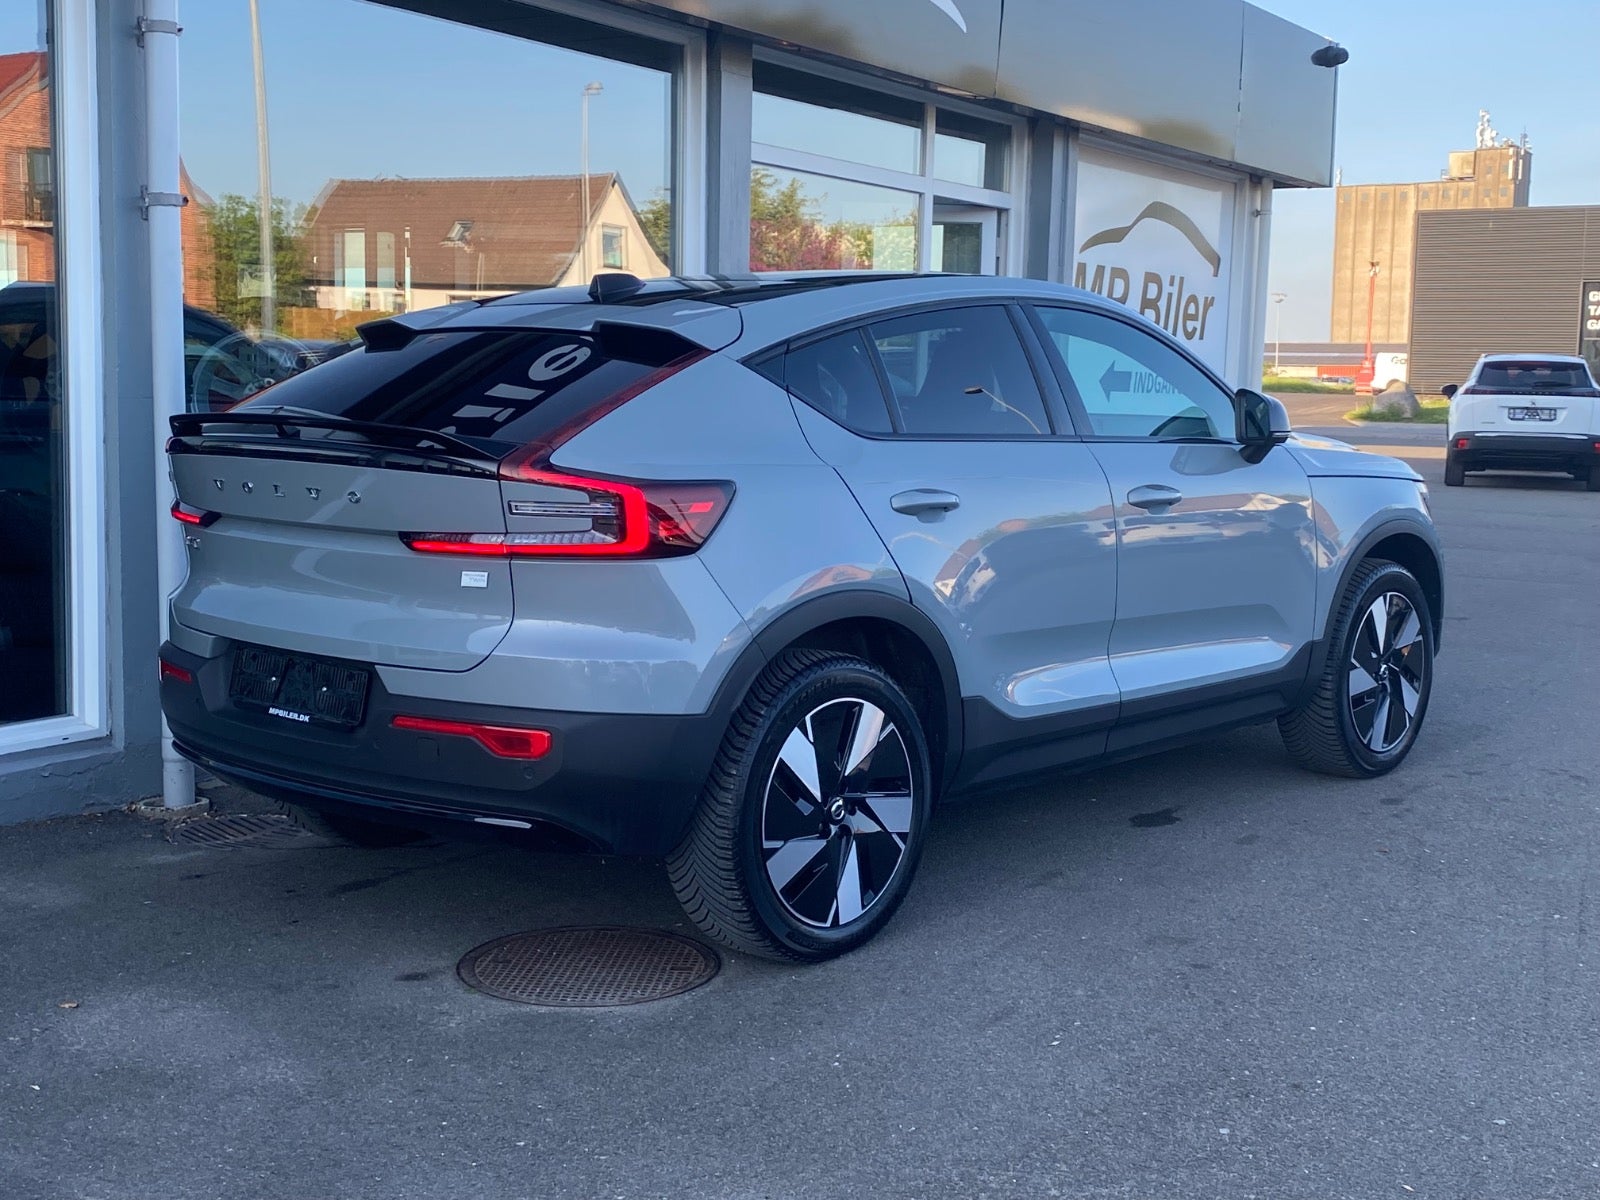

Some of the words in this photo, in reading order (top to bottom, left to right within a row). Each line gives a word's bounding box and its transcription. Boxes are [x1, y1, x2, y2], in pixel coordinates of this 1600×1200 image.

[1139, 271, 1215, 341] Biler
[212, 478, 362, 504] VOLVO
[268, 707, 310, 722] MPBILER.DK
